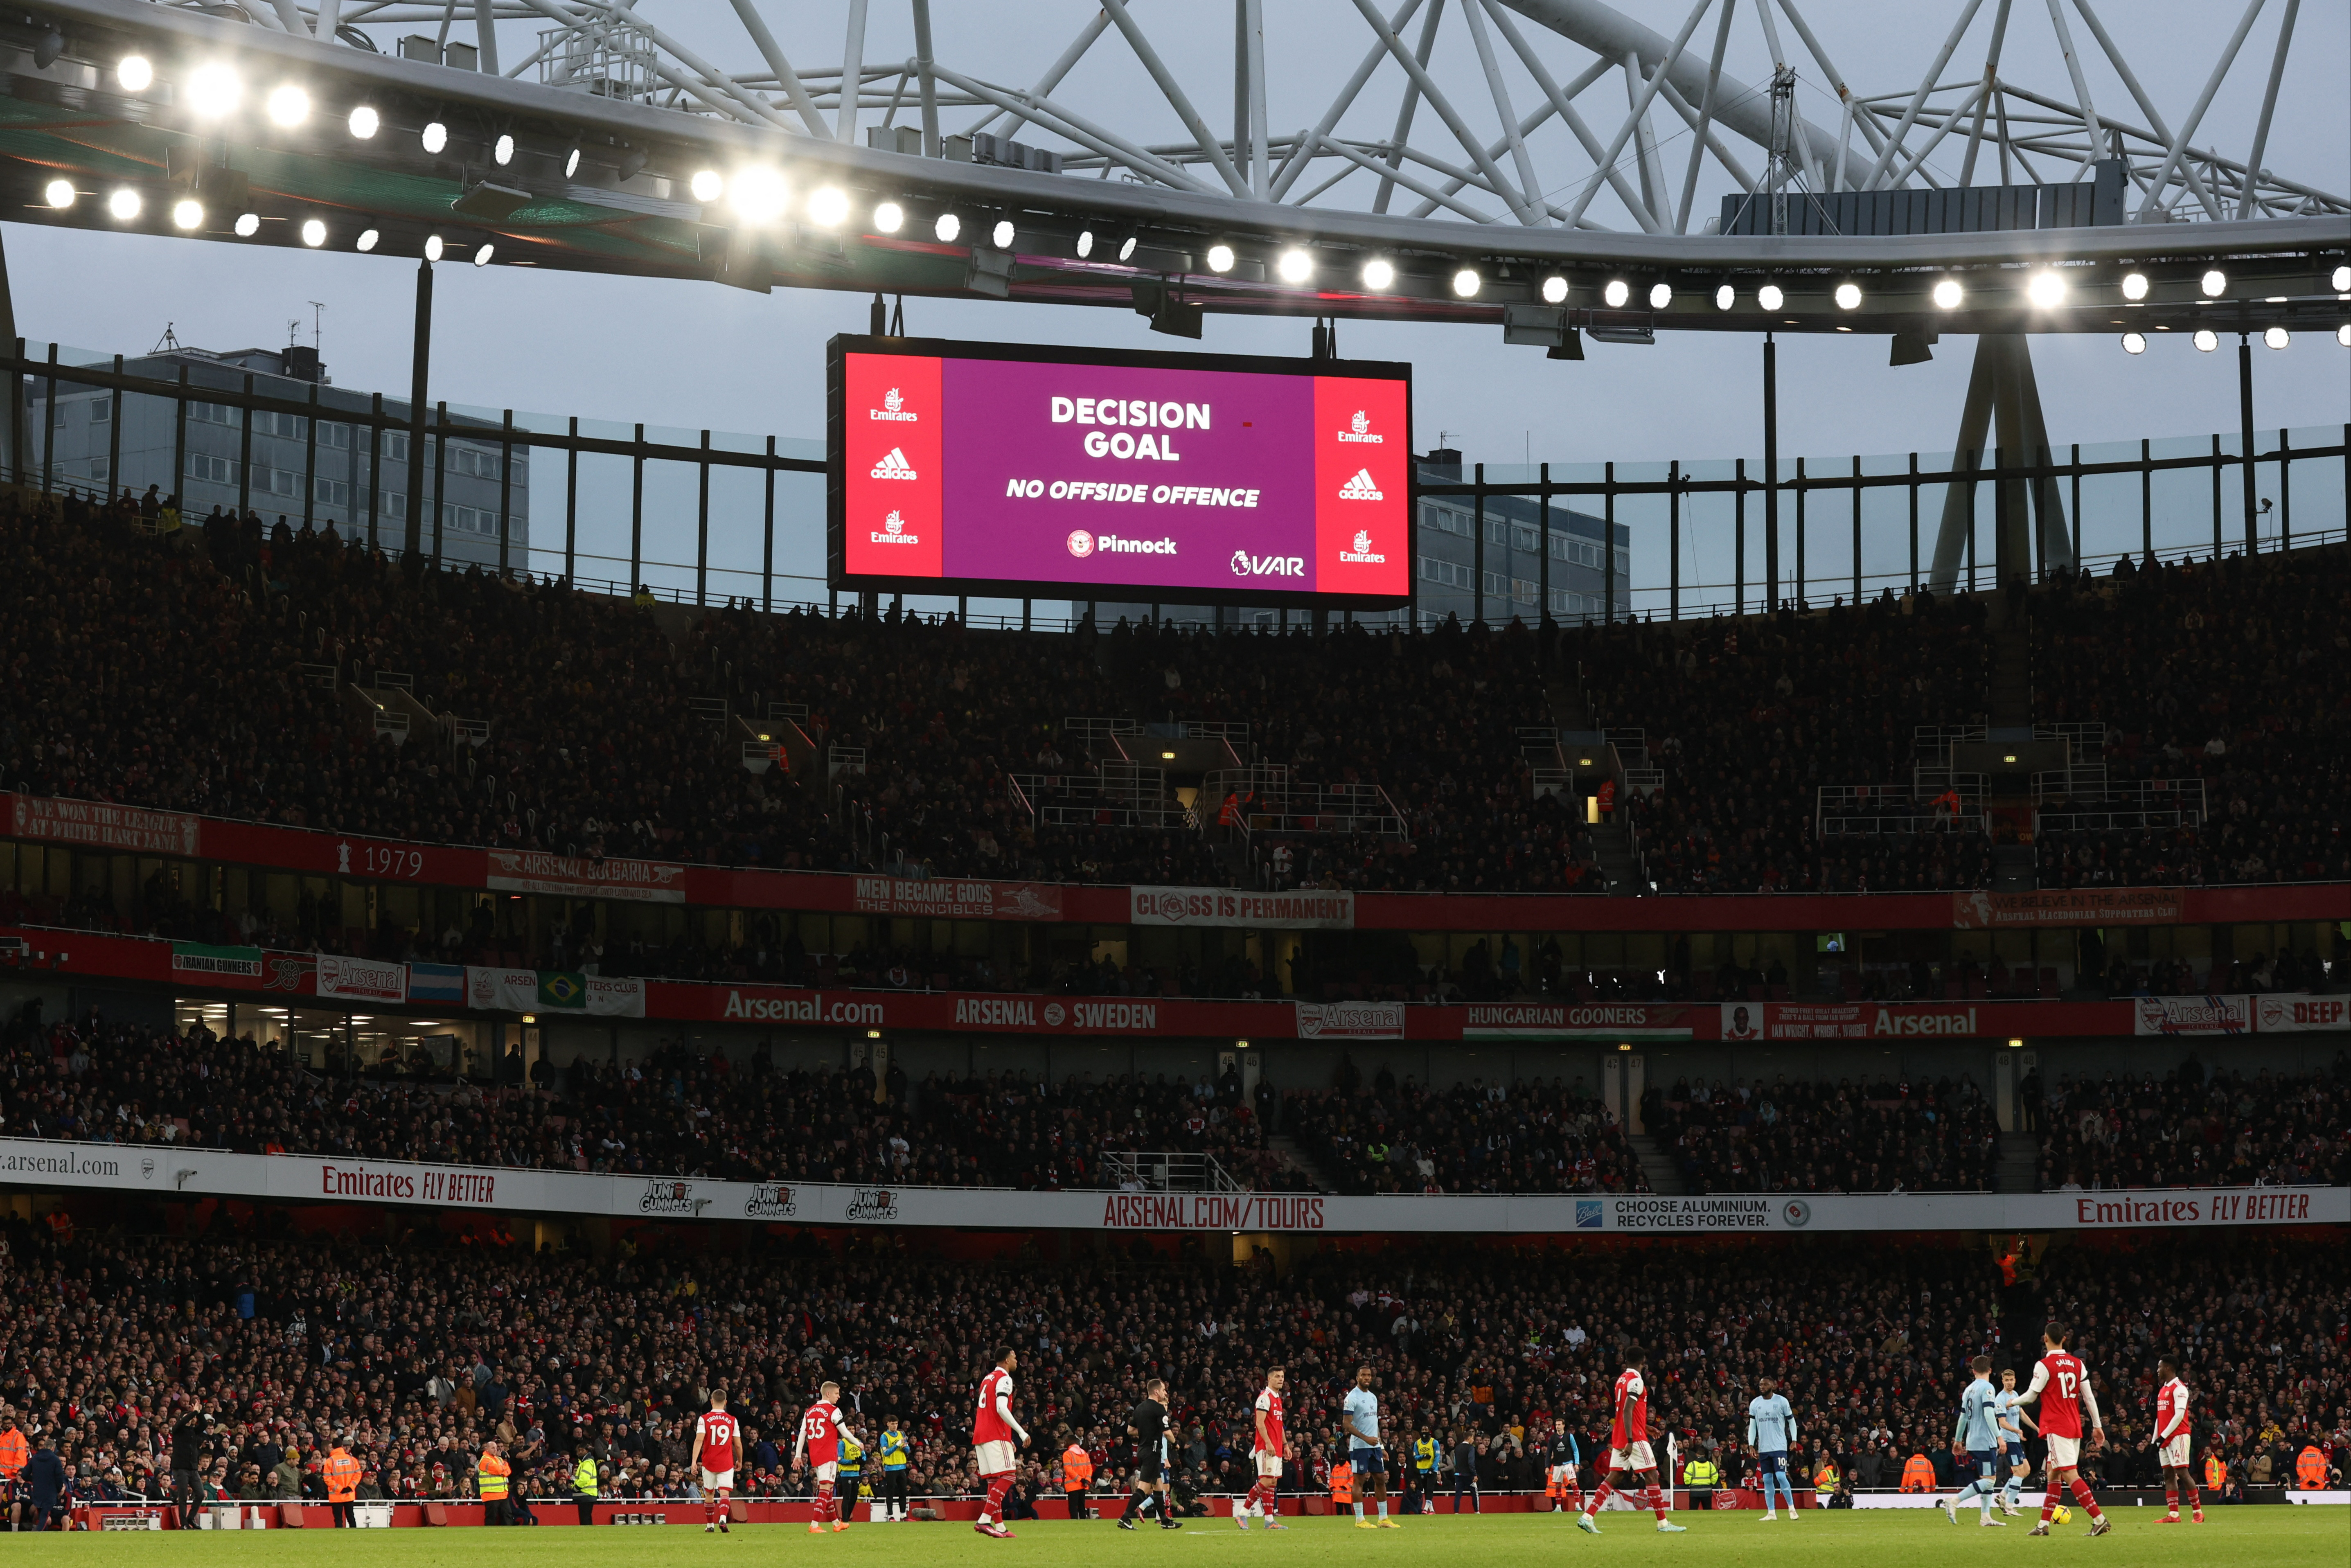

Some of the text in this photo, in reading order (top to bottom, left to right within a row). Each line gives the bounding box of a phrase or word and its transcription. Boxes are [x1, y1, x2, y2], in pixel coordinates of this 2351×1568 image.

[870, 408, 917, 422] Emirates
[1051, 396, 1210, 430] DECISION
[1084, 431, 1179, 461] GOAL
[1338, 431, 1383, 444] Emirates
[870, 465, 917, 480] adidas
[1006, 479, 1260, 508] NO OFFSIDE OFFENCE
[1339, 484, 1384, 501] adidas
[871, 531, 918, 545] Emirates
[1098, 534, 1177, 555] Pinnock
[1339, 551, 1386, 563] Emirates
[1251, 556, 1305, 577] VAR
[32, 800, 177, 832] WE WON THE LEAGUE
[29, 818, 178, 851] AT WHITE HART LANE
[365, 847, 422, 877] 1979
[524, 854, 650, 883] ARSENAL BULGARIA
[522, 881, 531, 890] WE
[532, 882, 541, 890] ALL
[542, 883, 563, 892] FOLLOW
[564, 885, 574, 893] THE
[576, 886, 598, 895] ARSENAL
[600, 888, 613, 896] OVER
[629, 890, 640, 898] AND
[857, 878, 993, 903] MEN BECAME GODS
[857, 899, 993, 915] THE INVINCIBLES
[1218, 897, 1235, 917] IS
[1240, 897, 1348, 919] PERMANENT
[1995, 893, 2178, 908] WE BELIEVE IN THE ARSENAL
[183, 956, 251, 974] IRANIAN GUNNERS
[339, 961, 402, 989] Arsenal
[504, 975, 536, 986] ARSEN
[614, 984, 638, 993] CLUB
[724, 990, 884, 1023] Arsenal.com
[956, 998, 1156, 1029] ARSENAL SWEDEN
[1323, 1005, 1402, 1026] Arsenal
[1469, 1007, 1646, 1024] HUNGARIAN GOONERS
[2166, 999, 2244, 1022] Arsenal
[2295, 1002, 2343, 1023] DEEP
[1874, 1007, 1976, 1035] Arsenal
[528, 1032, 537, 1043] 44
[1772, 1024, 1867, 1038] IAN WRIGHT, WRIGHT, WRIGHT
[854, 1047, 863, 1057] 45
[876, 1048, 885, 1058] 45
[1223, 1056, 1233, 1066] 46
[1999, 1055, 2009, 1066] 48
[2024, 1055, 2033, 1065] 48
[1247, 1057, 1257, 1066] 46
[1607, 1059, 1617, 1069] 47
[1631, 1059, 1641, 1068] 47
[0, 1152, 119, 1176] .arsenal.com
[322, 1166, 494, 1203] Emirates FLY BETTER
[1104, 1196, 1323, 1228] ARSENAL.COM/TOURS
[1578, 1205, 1602, 1222] Ball
[1615, 1201, 1771, 1213] CHOOSE ALUMINIUM.
[2076, 1194, 2309, 1223] Emirates FLY BETTER
[1617, 1215, 1769, 1227] RECYCLES FOREVER.
[2056, 1358, 2074, 1367] SALIBA
[2057, 1372, 2076, 1399] 12
[978, 1384, 987, 1408] 6
[806, 1407, 828, 1417] ZINCHENKO
[1967, 1398, 1972, 1420] 8
[707, 1415, 731, 1424] TROSSARD
[807, 1418, 825, 1439] 35
[710, 1425, 730, 1445] 19
[1778, 1457, 1785, 1466] 10
[2171, 1449, 2180, 1460] 14
